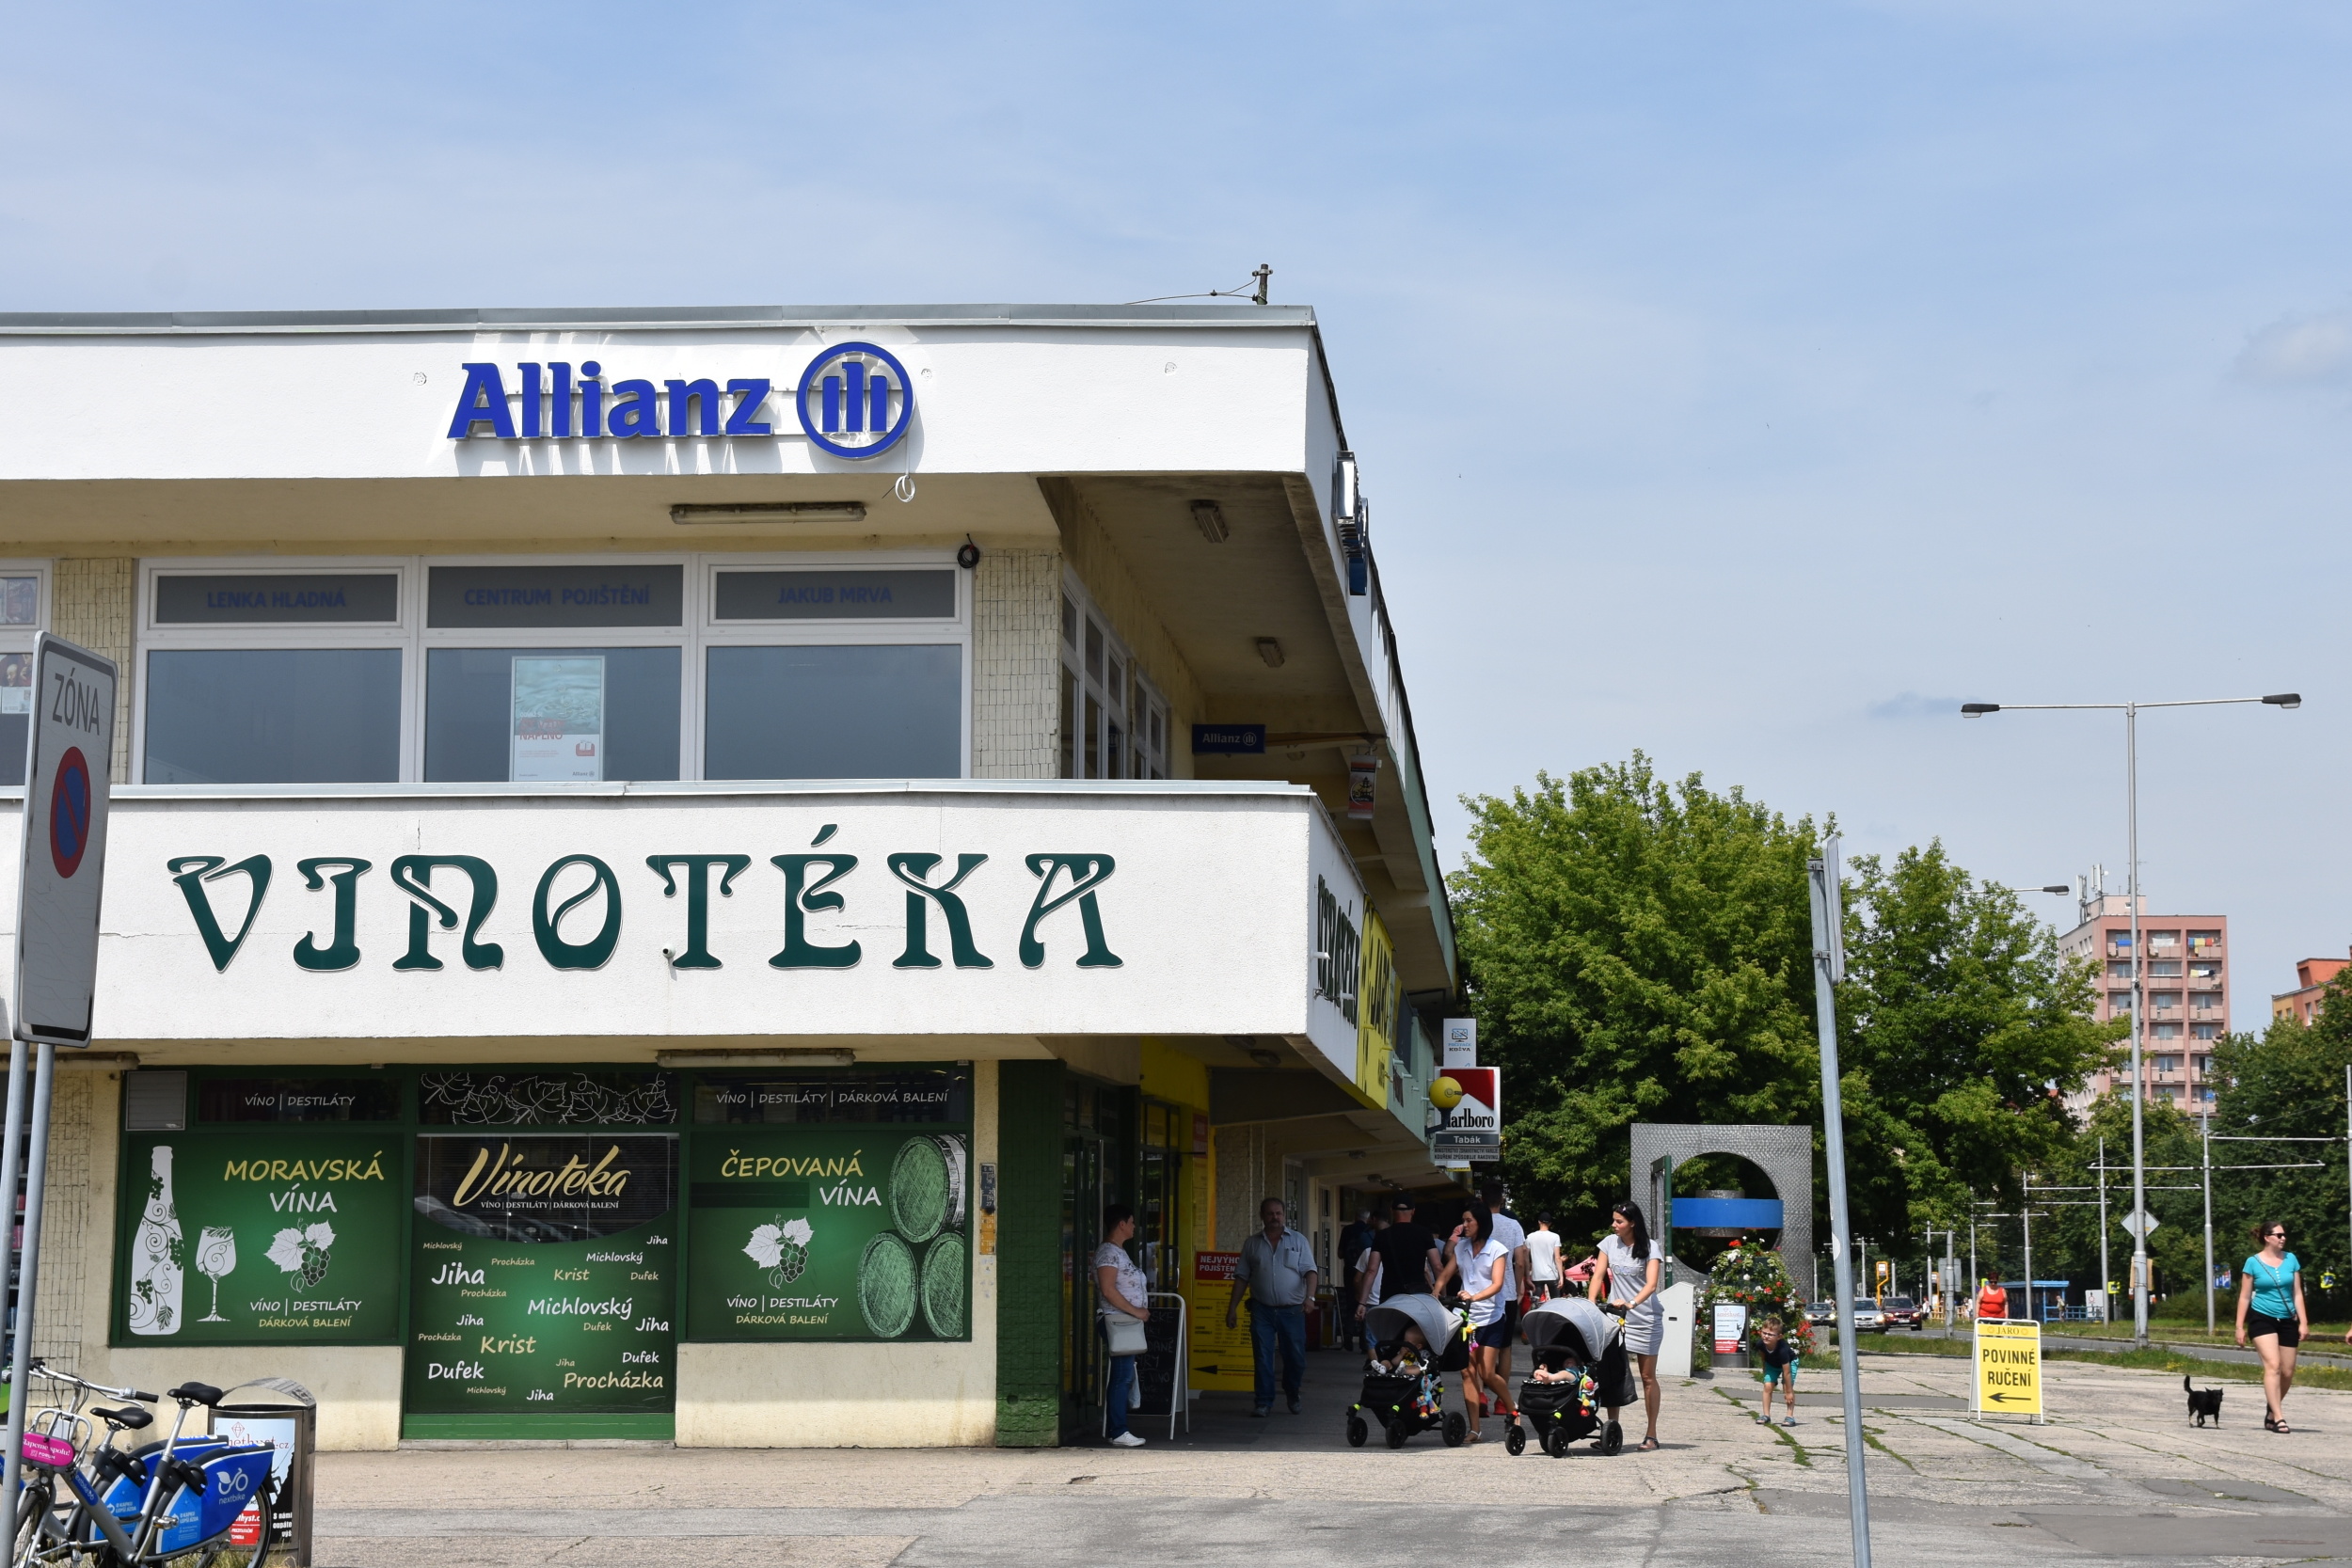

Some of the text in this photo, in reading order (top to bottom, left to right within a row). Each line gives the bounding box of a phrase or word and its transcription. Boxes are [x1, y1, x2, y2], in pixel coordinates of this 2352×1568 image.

[447, 360, 771, 439] Allianz
[207, 587, 346, 609] LENKA HLADNÁ
[464, 583, 650, 606] CENTRUM POJIŠTĚNÍ
[778, 586, 893, 605] JAKUB MRVA
[53, 667, 101, 736] ZÓNA
[1202, 733, 1241, 744] Allianz
[166, 823, 1125, 973] VINOTÉKA
[245, 1094, 356, 1107] VÍNO DESTILÁTY
[716, 1089, 949, 1104] VÍNO DESTILÁTY DÁRKOVÁ BALENÍ
[1447, 1108, 1494, 1128] arlboro
[1454, 1135, 1481, 1144] Tabák
[224, 1150, 385, 1181] MORAVSKÁ
[721, 1148, 864, 1178] ČEPOVANÁ
[269, 1183, 338, 1213] VÍNA
[819, 1179, 882, 1206] VÍNA
[481, 1200, 619, 1209] VÍNO DESTILÁTY DÁRKOVÁ BALENÍ
[423, 1242, 463, 1251] Michlovský
[646, 1235, 668, 1245] Jiha
[491, 1257, 535, 1266] Procházka
[586, 1251, 644, 1264] Michlovský
[1200, 1254, 1240, 1264] NEJVÝHO
[431, 1262, 485, 1285] Jiha
[1199, 1263, 1235, 1272] POJIŠTĚN
[553, 1268, 590, 1281] Krist
[630, 1272, 659, 1281] Dufek
[461, 1289, 507, 1298] Procházka
[250, 1297, 362, 1312] VÍNO DESTILÁTY
[726, 1294, 838, 1308] VÍNO DESTILÁTY
[527, 1297, 632, 1320] Michlovský
[259, 1315, 352, 1328] DÁRKOVÁ BALENÍ
[456, 1314, 484, 1326] Jiha
[635, 1317, 669, 1332] Jiha
[736, 1312, 830, 1324] DÁRKOVÁ BALENÍ
[583, 1322, 612, 1331] Dufek
[1995, 1326, 2020, 1336] JARO
[418, 1332, 462, 1342] Procházka
[480, 1334, 536, 1354] Krist
[555, 1357, 575, 1367] Jiha
[622, 1351, 660, 1364] Dufek
[1982, 1348, 2035, 1365] POVINNÉ
[428, 1360, 485, 1380] Dufek
[564, 1370, 663, 1389] Procházka
[1988, 1368, 2031, 1387] RUČENÍ
[467, 1386, 506, 1395] Michlovský
[526, 1389, 554, 1402] Jiha
[218, 1493, 246, 1505] nextbike
